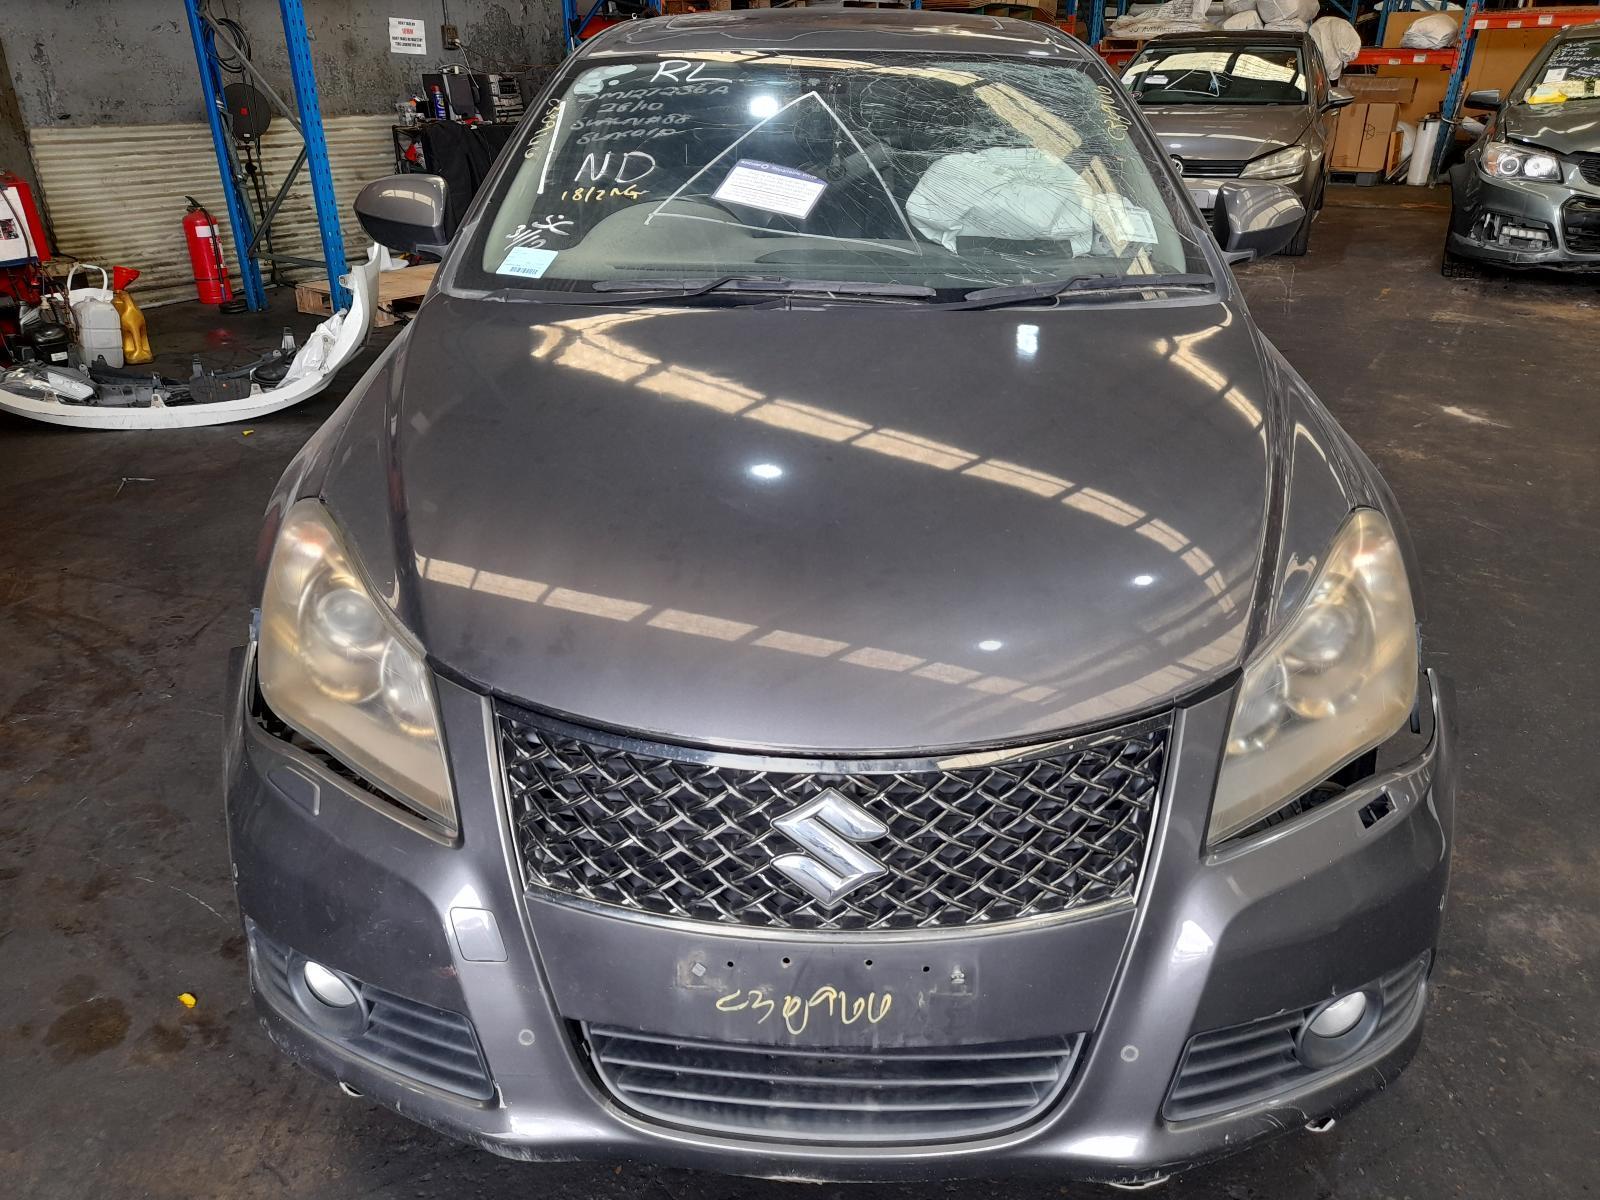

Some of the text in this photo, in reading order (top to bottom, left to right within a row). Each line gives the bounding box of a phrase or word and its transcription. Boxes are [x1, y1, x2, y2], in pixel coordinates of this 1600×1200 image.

[649, 59, 733, 84] RL
[575, 150, 656, 183] ND
[561, 186, 606, 203] 18/2
